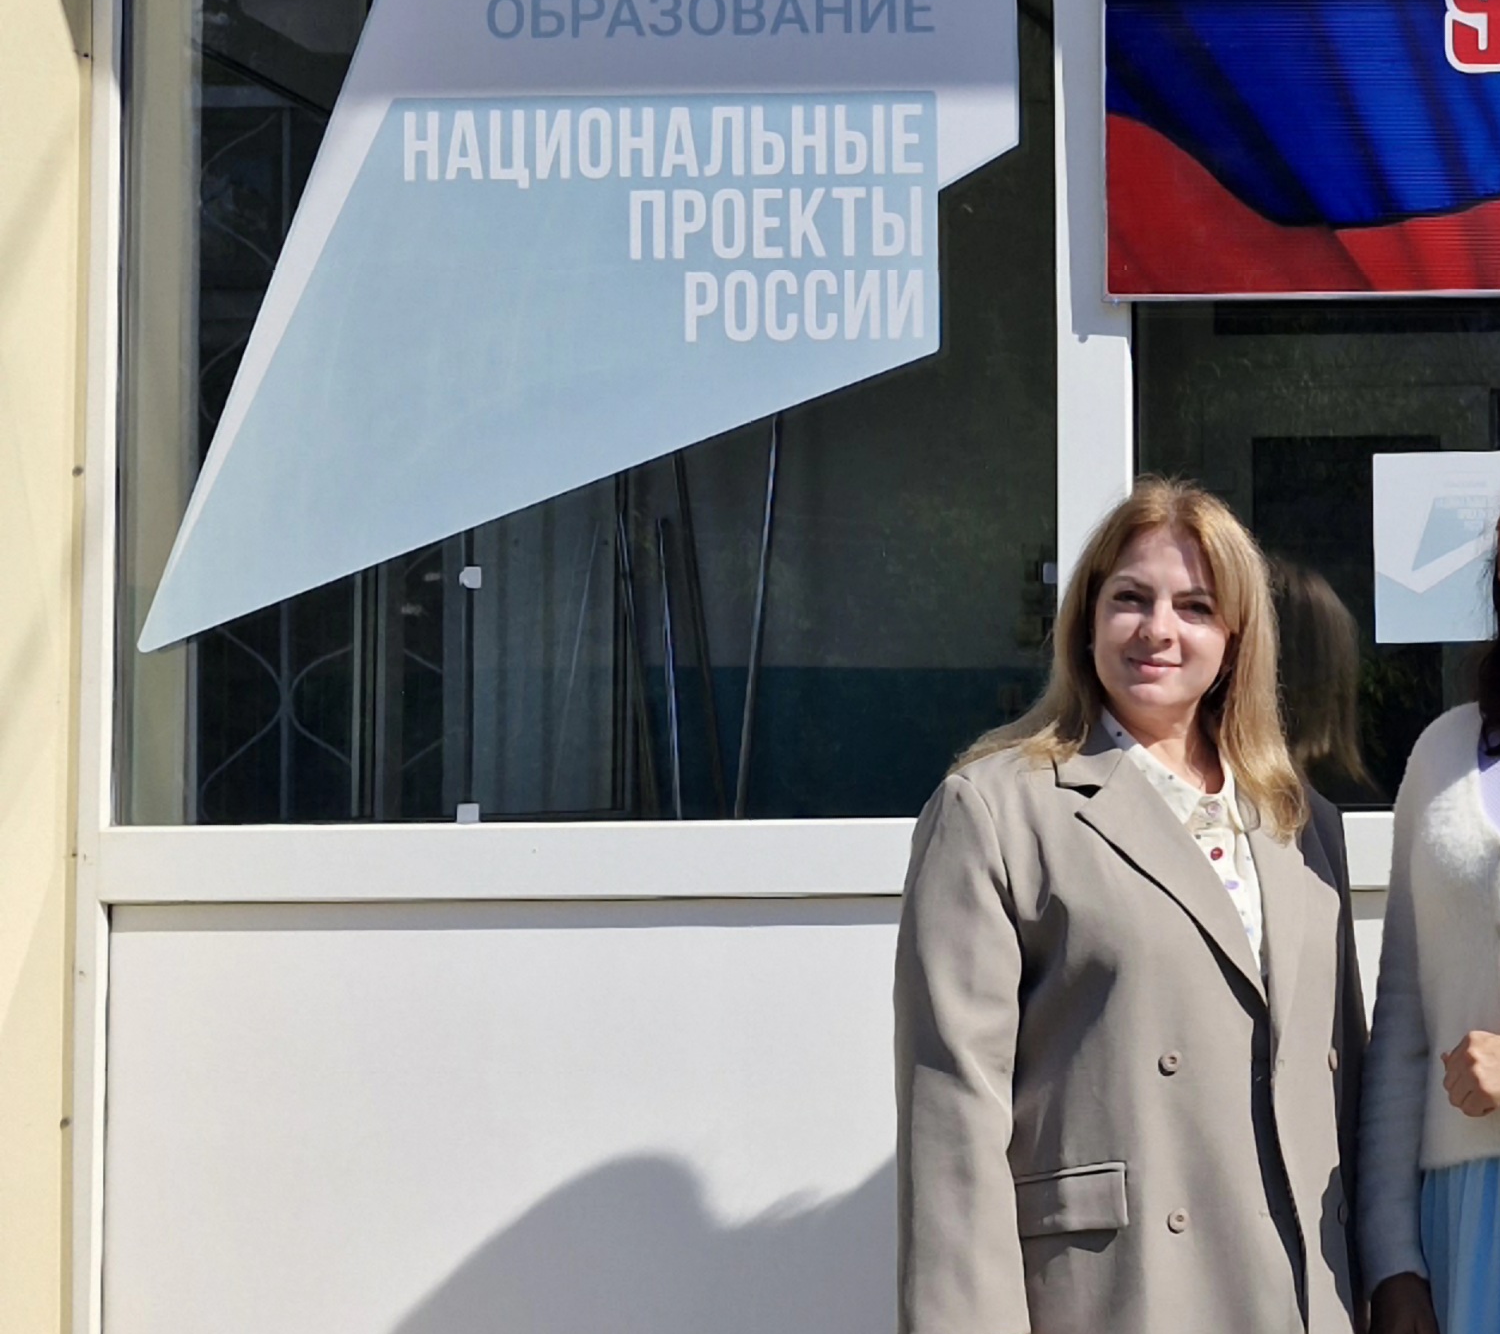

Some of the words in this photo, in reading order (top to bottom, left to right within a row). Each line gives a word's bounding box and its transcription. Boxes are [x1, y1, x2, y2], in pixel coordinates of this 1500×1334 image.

[402, 104, 925, 189] НАЦИОНАЛЬНЫЕ
[629, 185, 924, 260] ПРОЕКТЫ
[684, 269, 925, 343] РОССИИ
